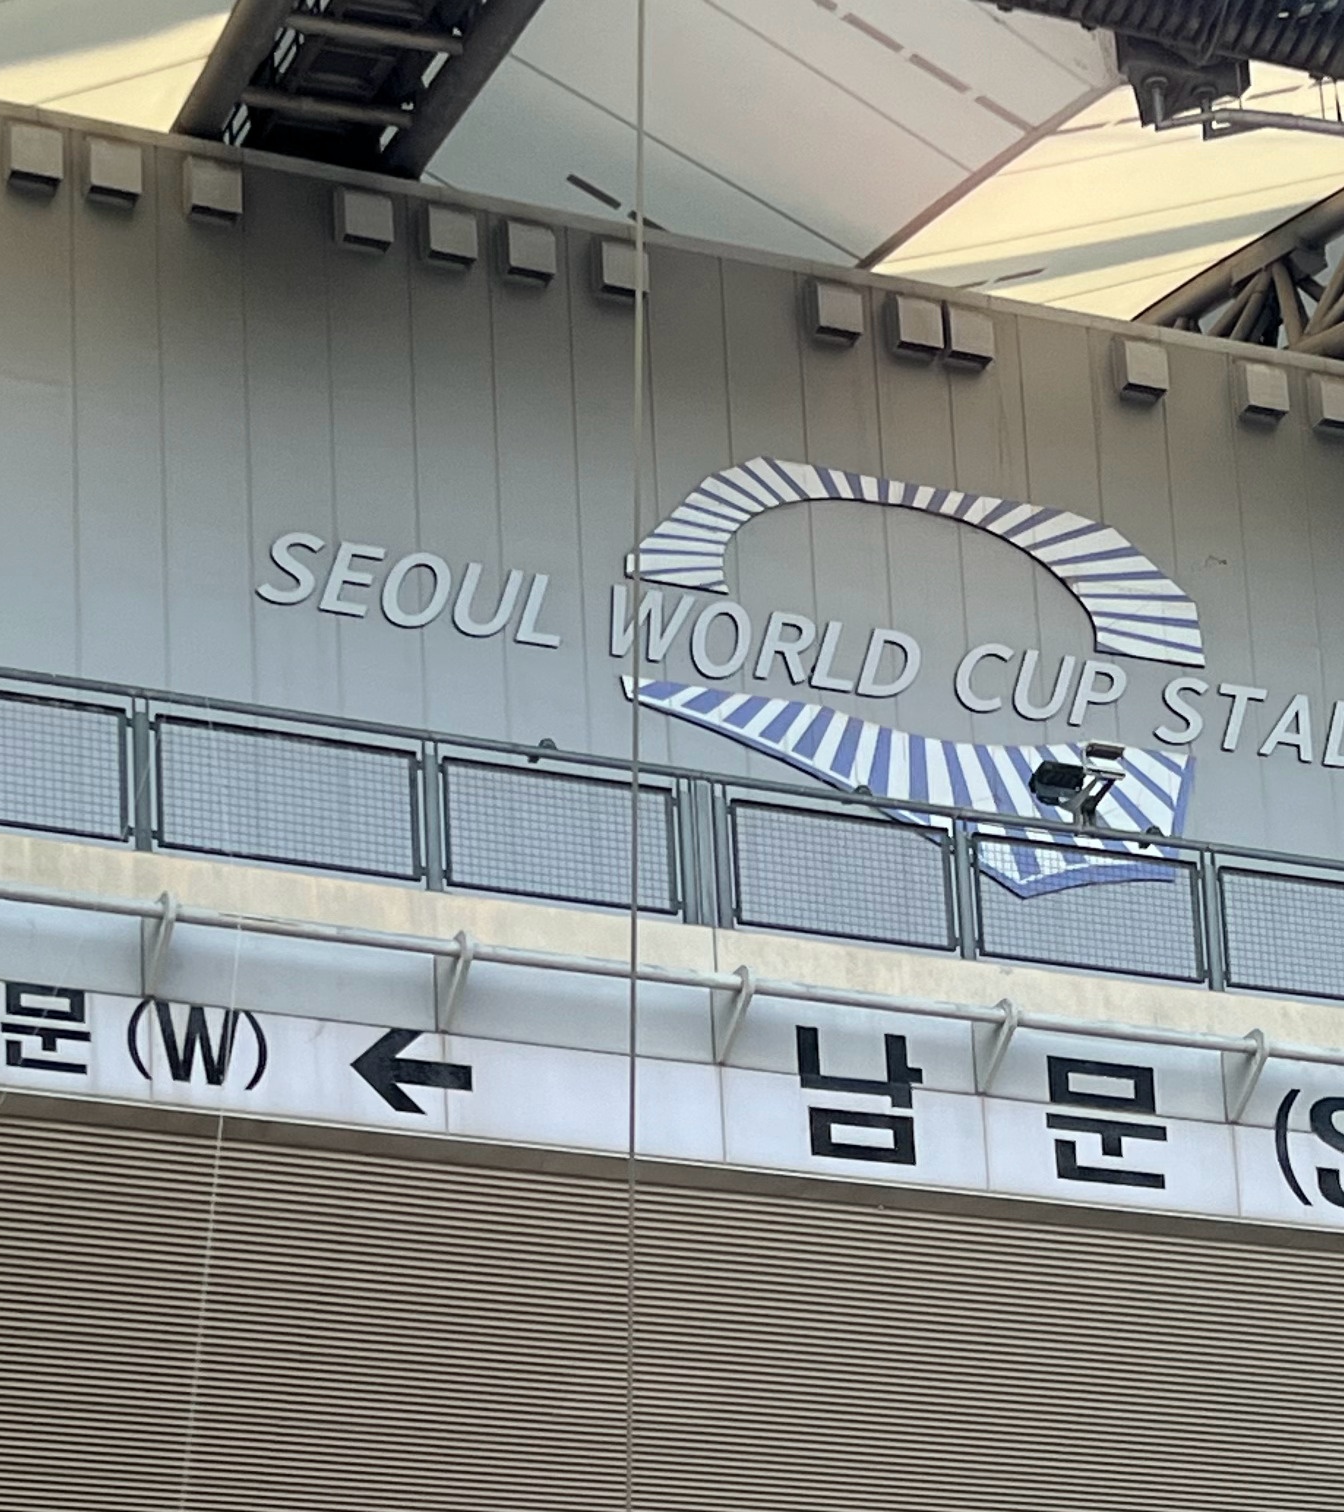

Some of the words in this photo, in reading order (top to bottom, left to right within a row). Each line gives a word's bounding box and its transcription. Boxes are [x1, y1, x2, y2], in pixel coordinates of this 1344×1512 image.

[256, 531, 563, 648] SEOUL
[608, 582, 924, 702] WORLD
[953, 640, 1129, 730] CUP
